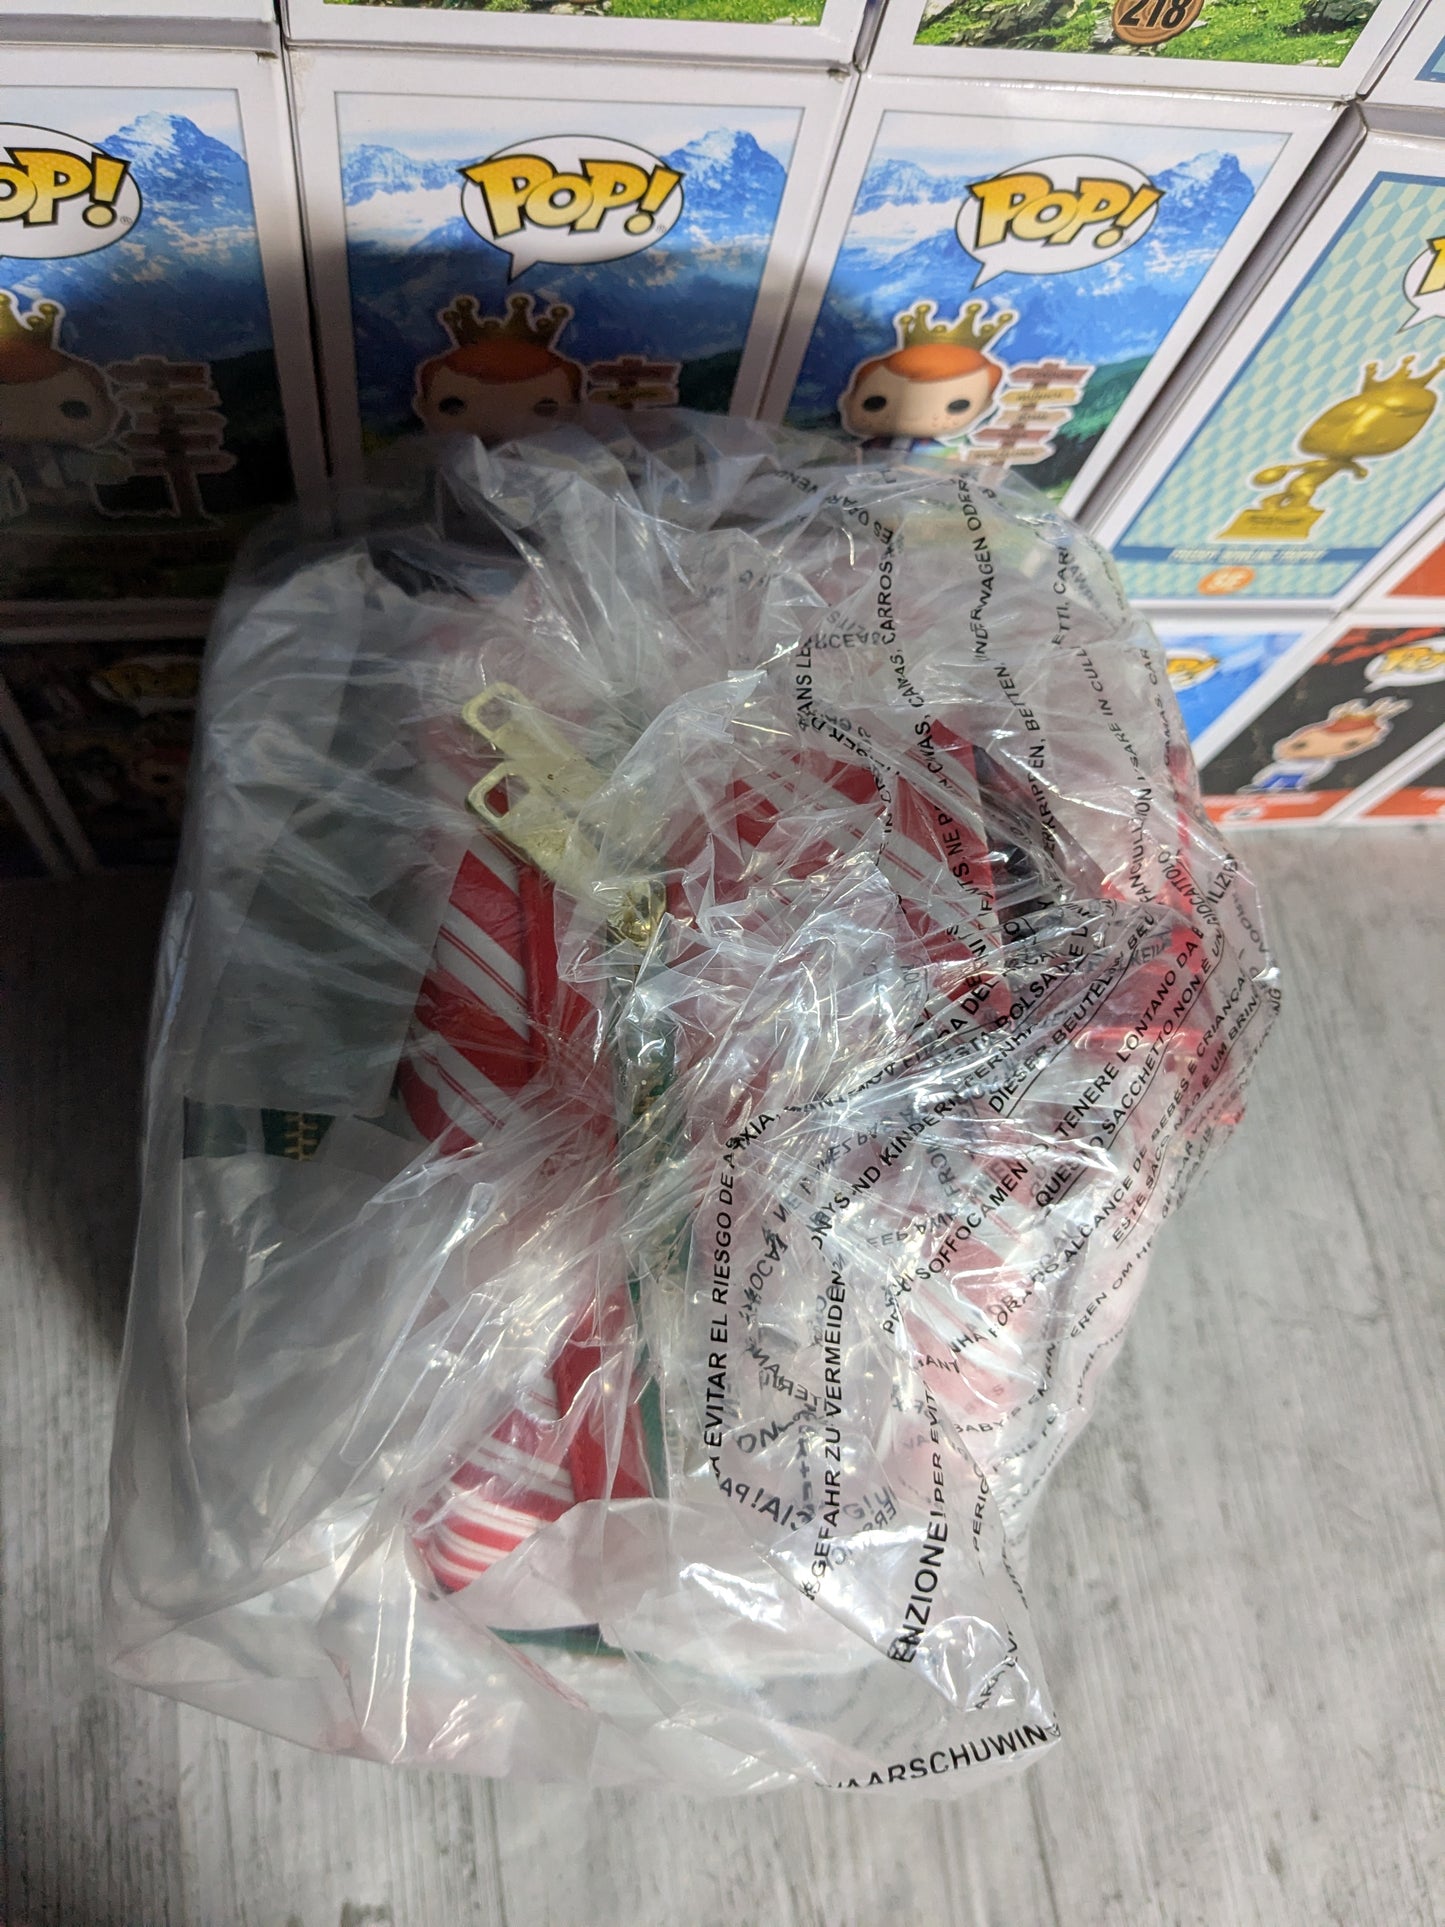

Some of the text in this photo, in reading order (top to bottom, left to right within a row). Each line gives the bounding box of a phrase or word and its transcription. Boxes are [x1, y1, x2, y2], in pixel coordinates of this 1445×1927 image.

[1117, 0, 1194, 28] 218
[0, 147, 130, 229] OP!
[457, 153, 685, 239] POP!
[964, 172, 1166, 250] POP!
[1071, 645, 1104, 692] CULL
[1098, 699, 1115, 716] IN
[943, 829, 964, 855] NE
[1101, 1019, 1175, 1134] SACCHETTO
[1173, 975, 1201, 1018] NON
[1211, 928, 1223, 956] UN
[718, 1173, 734, 1205] DE
[932, 1453, 945, 1502] PER
[1053, 1061, 1120, 1137] TENERE
[1115, 969, 1178, 1063] LONTANO
[1176, 940, 1200, 968] DA
[1063, 1174, 1133, 1263] ALCANCE
[1132, 1145, 1148, 1173] DE
[711, 1212, 733, 1305] RIESGO
[710, 1314, 728, 1342] EL
[703, 1352, 727, 1447] EVITAR
[825, 1427, 841, 1462] ZU
